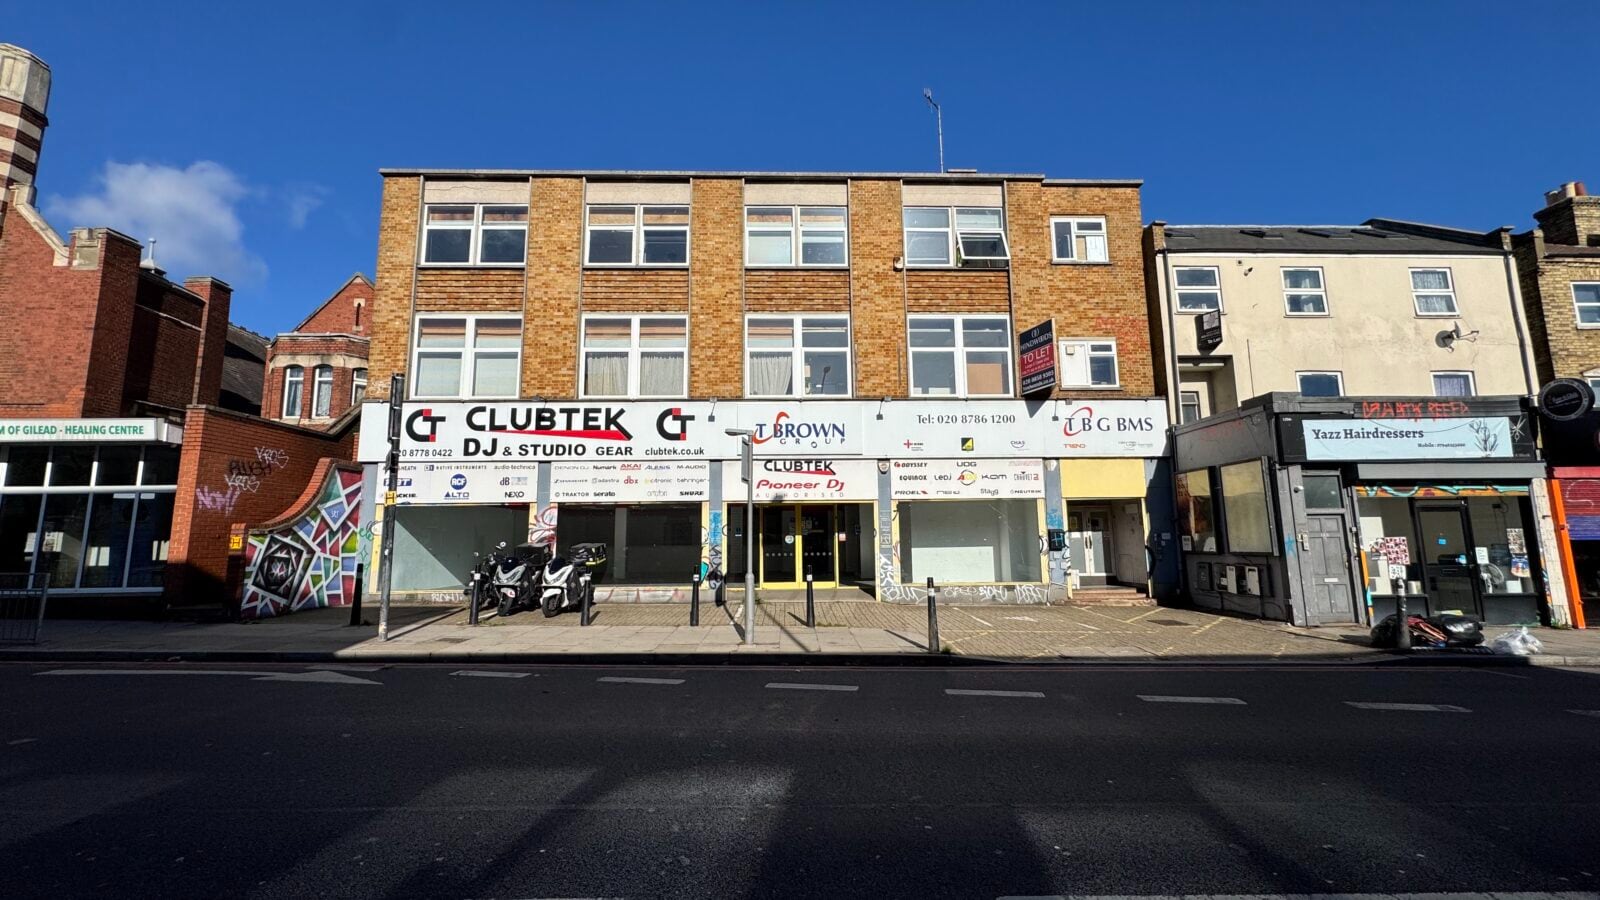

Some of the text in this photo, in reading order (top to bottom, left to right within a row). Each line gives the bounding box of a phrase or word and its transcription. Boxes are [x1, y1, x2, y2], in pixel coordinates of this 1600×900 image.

[1023, 353, 1034, 364] TO
[1036, 345, 1051, 360] LET
[466, 406, 633, 441] CLUBTEK
[917, 414, 1016, 424] Tel: 020 8786 1200
[1082, 418, 1092, 431] B
[1097, 418, 1110, 431] G
[1117, 418, 1153, 431] BMS
[7, 426, 20, 435] OF
[23, 425, 57, 435] GILEAD
[65, 425, 106, 434] HEALING
[109, 425, 144, 435] CENTRE
[773, 423, 846, 438] BROWN
[1312, 427, 1424, 440] Yazz Hairdressers
[463, 438, 633, 457] DJ & STUDIO GEAR
[780, 438, 845, 448] GROUP
[408, 449, 430, 457] 8778
[432, 449, 453, 457] 0422
[645, 446, 705, 456] clubtek.co.uk
[764, 460, 836, 475] CLUBTEK
